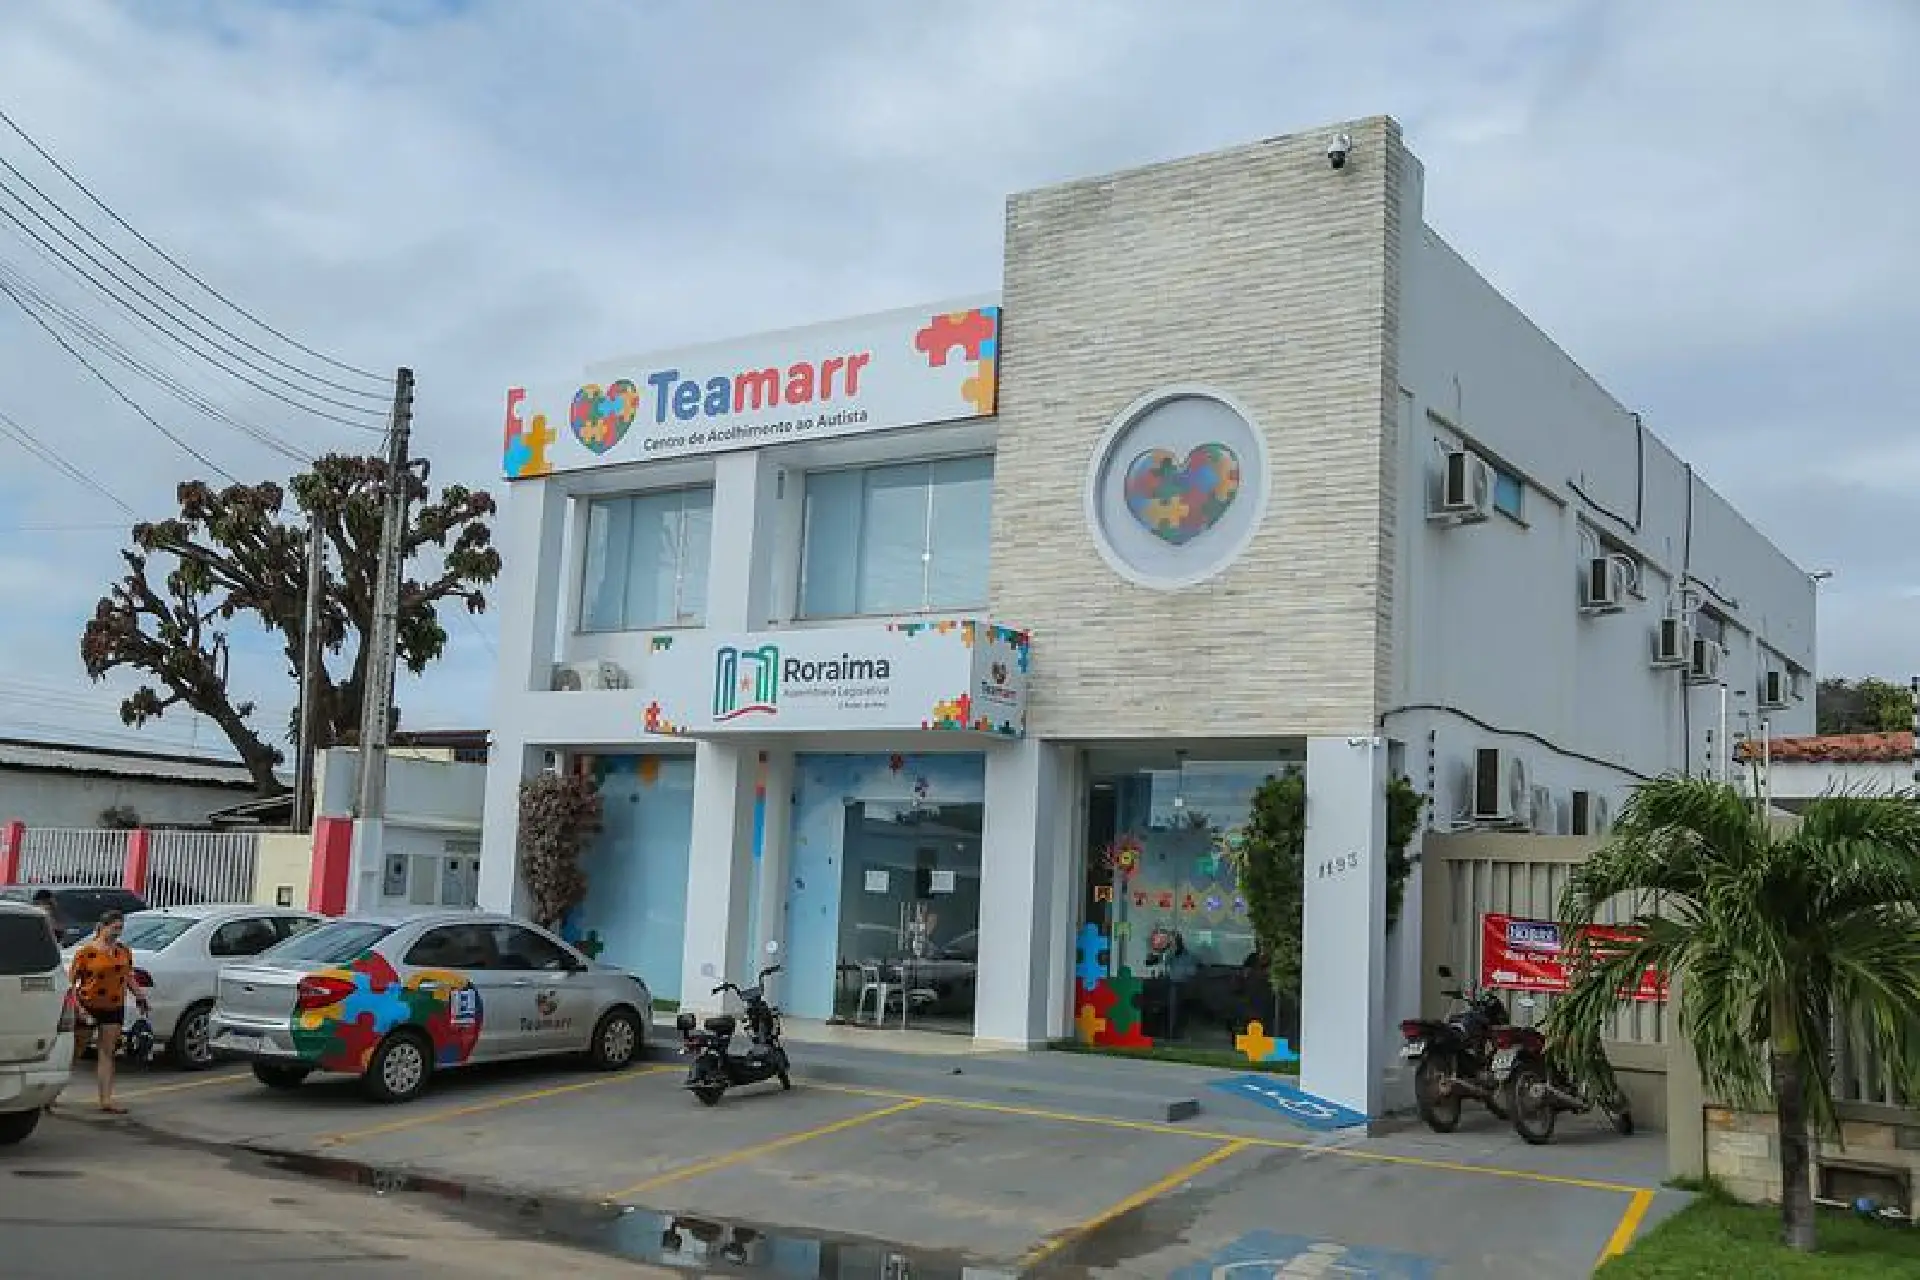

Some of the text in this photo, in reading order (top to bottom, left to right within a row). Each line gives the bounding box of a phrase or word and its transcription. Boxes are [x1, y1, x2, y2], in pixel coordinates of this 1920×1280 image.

[648, 352, 870, 423] Teamarr
[644, 409, 868, 451] Centro de Acolhimento ao Autista
[783, 653, 890, 683] Roraima
